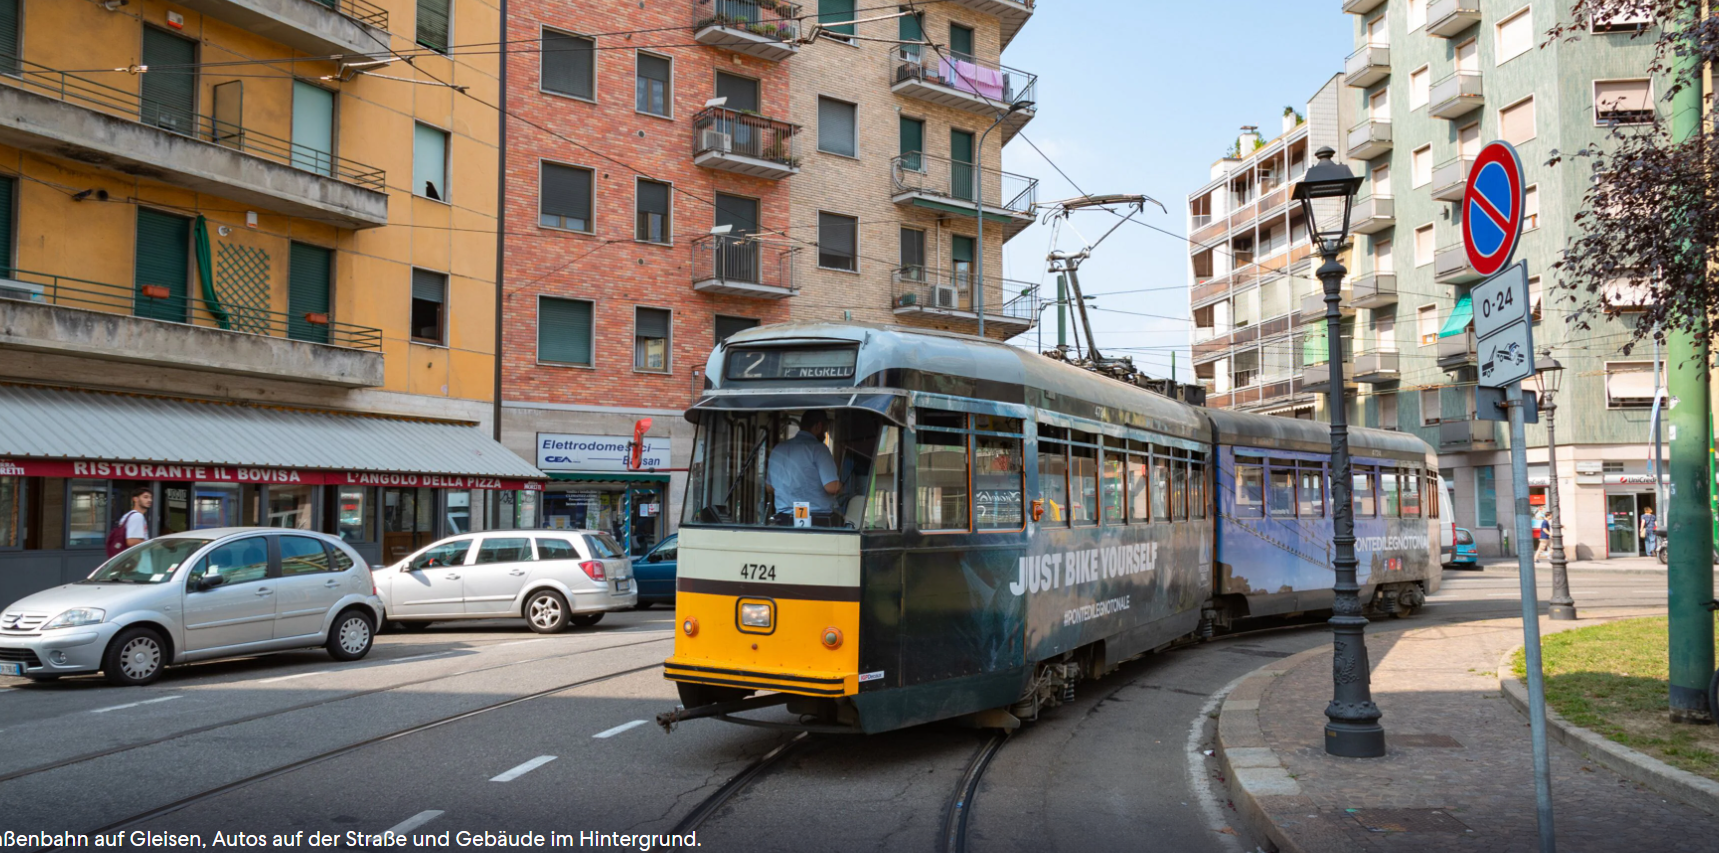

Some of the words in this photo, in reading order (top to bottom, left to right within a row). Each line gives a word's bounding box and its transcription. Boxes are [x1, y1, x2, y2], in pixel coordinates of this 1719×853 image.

[1482, 286, 1513, 318] 0-24
[743, 352, 765, 377] 2
[542, 439, 651, 453] Elettrodomesci
[622, 455, 660, 466] Bsan
[73, 461, 207, 479] RISTORANTE
[214, 467, 231, 480] IL
[238, 467, 301, 482] BOVISA
[422, 475, 463, 487] DELLA
[467, 477, 502, 489] PIZZA
[740, 563, 776, 581] 4724
[1009, 552, 1062, 596] JUST
[1065, 548, 1099, 587] BIKE
[1100, 541, 1158, 580] YOURSELF
